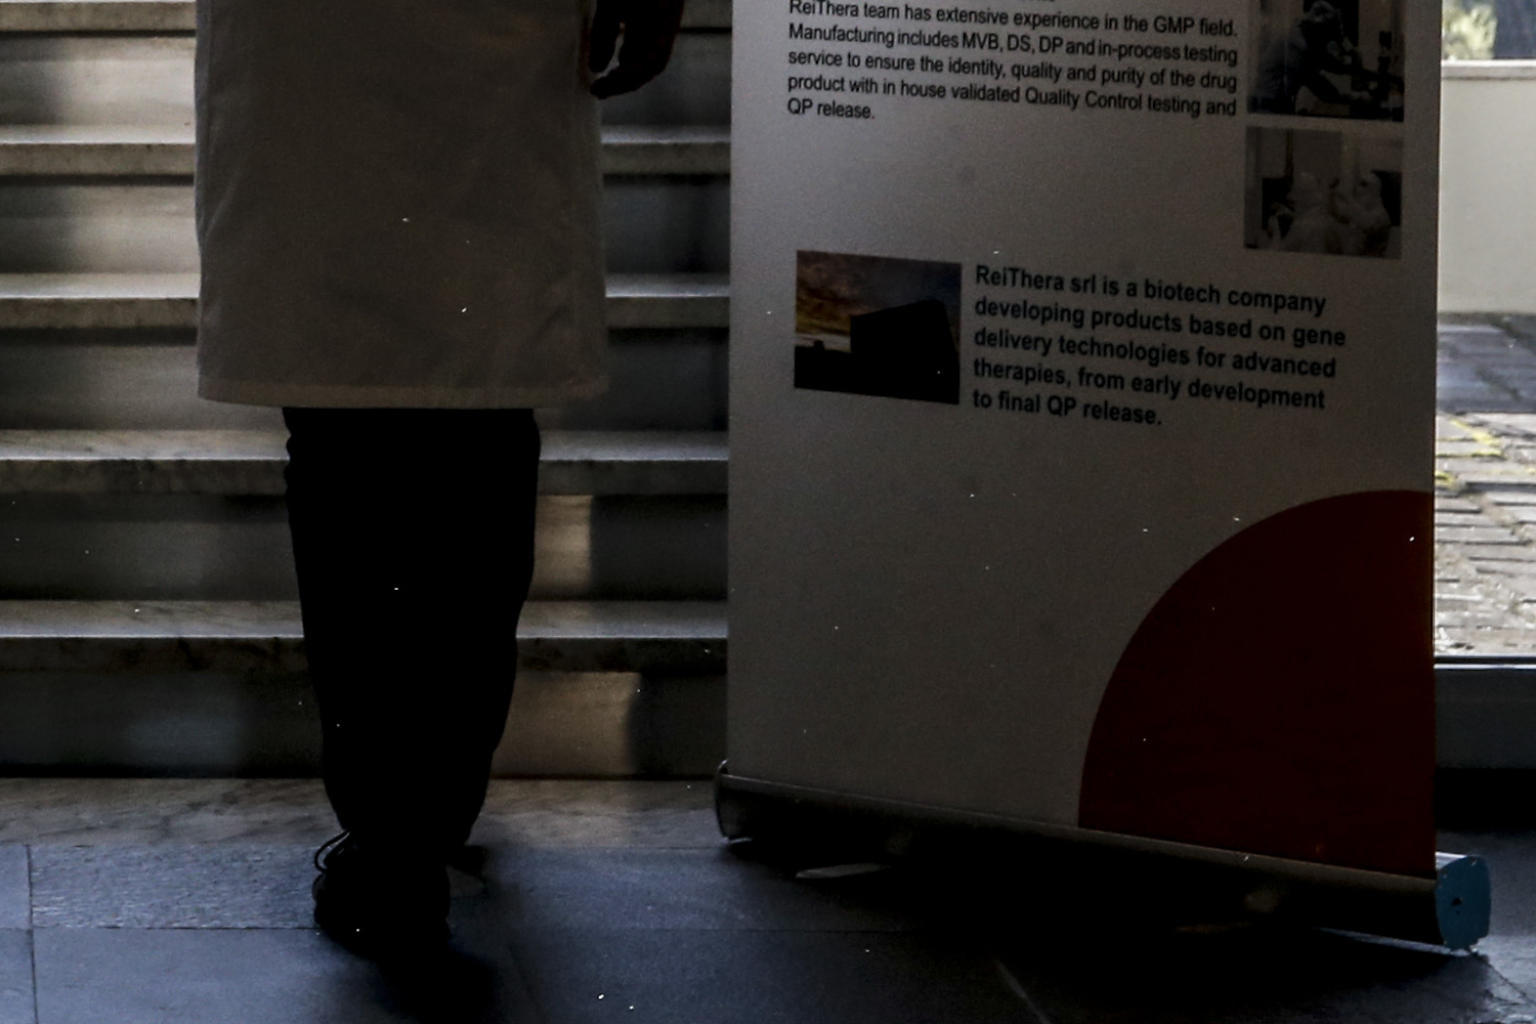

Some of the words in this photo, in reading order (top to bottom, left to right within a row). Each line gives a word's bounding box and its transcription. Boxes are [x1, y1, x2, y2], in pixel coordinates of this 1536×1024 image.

[863, 3, 900, 19] team
[905, 4, 932, 21] has
[936, 7, 1008, 25] extensive
[1013, 11, 1100, 30] experience
[1104, 13, 1118, 30] in
[1123, 14, 1149, 32] the
[1153, 15, 1195, 34] GMP
[1199, 17, 1237, 37] field.
[789, 22, 894, 49] Manufacturing
[898, 30, 959, 48] includes
[962, 32, 1003, 52] MVB,
[1007, 34, 1035, 54] DS,
[1039, 35, 1063, 53] DP
[1066, 39, 1095, 56] and
[1098, 40, 1181, 61] in-process
[1184, 45, 1237, 68] testing
[788, 51, 842, 67] service
[847, 52, 860, 68] to
[865, 56, 915, 71] ensure
[920, 56, 943, 73] the
[949, 57, 1005, 80] identity,
[1011, 62, 1062, 84] quality
[1067, 65, 1096, 82] and
[1101, 67, 1145, 88] purity
[1150, 68, 1166, 85] of
[1170, 69, 1195, 87] the
[1200, 71, 1237, 94] drug
[787, 97, 813, 115] QP
[817, 100, 875, 119] release.
[788, 75, 845, 93] product
[849, 77, 878, 94] with
[883, 78, 896, 95] in
[900, 80, 946, 99] house
[951, 83, 1020, 103] validated
[1025, 86, 1080, 111] Quality
[1085, 90, 1142, 110] Control
[1147, 95, 1201, 119] testing
[1206, 99, 1236, 117] and
[976, 264, 1065, 291] ReiThera
[1070, 274, 1096, 294] srl
[1102, 275, 1120, 297] is
[1126, 281, 1138, 297] a
[1144, 278, 1221, 304] biotech
[1227, 290, 1327, 318] company
[975, 296, 1085, 329] developing
[1091, 308, 1182, 333] products
[1189, 314, 1252, 339] based
[1258, 325, 1285, 342] on
[1292, 327, 1346, 349] gene
[975, 327, 1052, 357] delivery
[1058, 335, 1190, 368] technologies
[1196, 346, 1226, 368] for
[1232, 351, 1337, 378] advanced
[974, 357, 1071, 388] therapies,
[1078, 366, 1125, 390] from
[1131, 374, 1182, 401] early
[1187, 377, 1325, 410] development
[972, 389, 992, 409] to
[998, 390, 1041, 413] final
[1046, 395, 1077, 417] QP
[1083, 400, 1162, 426] release.
